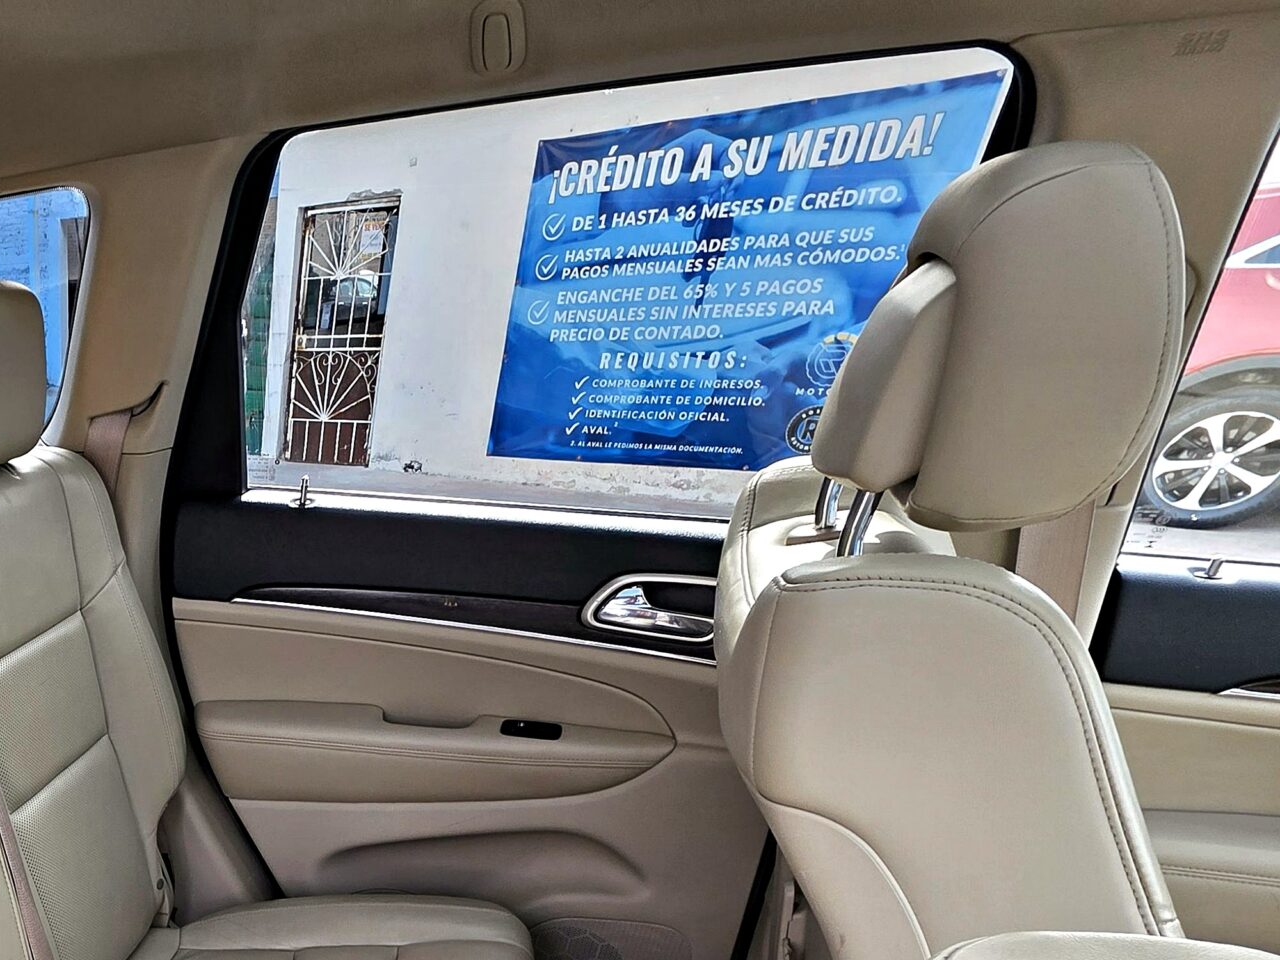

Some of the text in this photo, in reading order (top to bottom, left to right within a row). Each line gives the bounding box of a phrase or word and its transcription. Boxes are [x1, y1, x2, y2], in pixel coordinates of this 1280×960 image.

[548, 112, 945, 204] ¡CRÉDITO A SU MEDIDA!
[571, 185, 902, 232] DE 1 HASTA 36 MESES DE CRÉDITO.
[564, 227, 875, 263] HASTA 2 ANUALIDADES PARA QUE SUS
[561, 264, 609, 280] PAGOS
[612, 258, 703, 277] MENSUALES
[706, 255, 750, 272] SEAN
[754, 252, 793, 268] MAS
[556, 278, 824, 305] ENGANCHE DEL 65% Y 5 PAGOS
[553, 299, 834, 323] MENSUALES SIN INTERESES PARA
[549, 325, 724, 342] PRECIO DE CONTADO.
[599, 351, 747, 371] REQUISITOS:
[591, 379, 764, 389] COMPROBANTE DE INGRESOS.
[588, 394, 766, 407] COMPROBANTE DE DOMICILIO.
[585, 409, 730, 422] IDENTIFICACIÓN OFICIAL.
[613, 442, 643, 450] PEDIMOS
[678, 444, 743, 454] DOCUMENTACIÓN.
